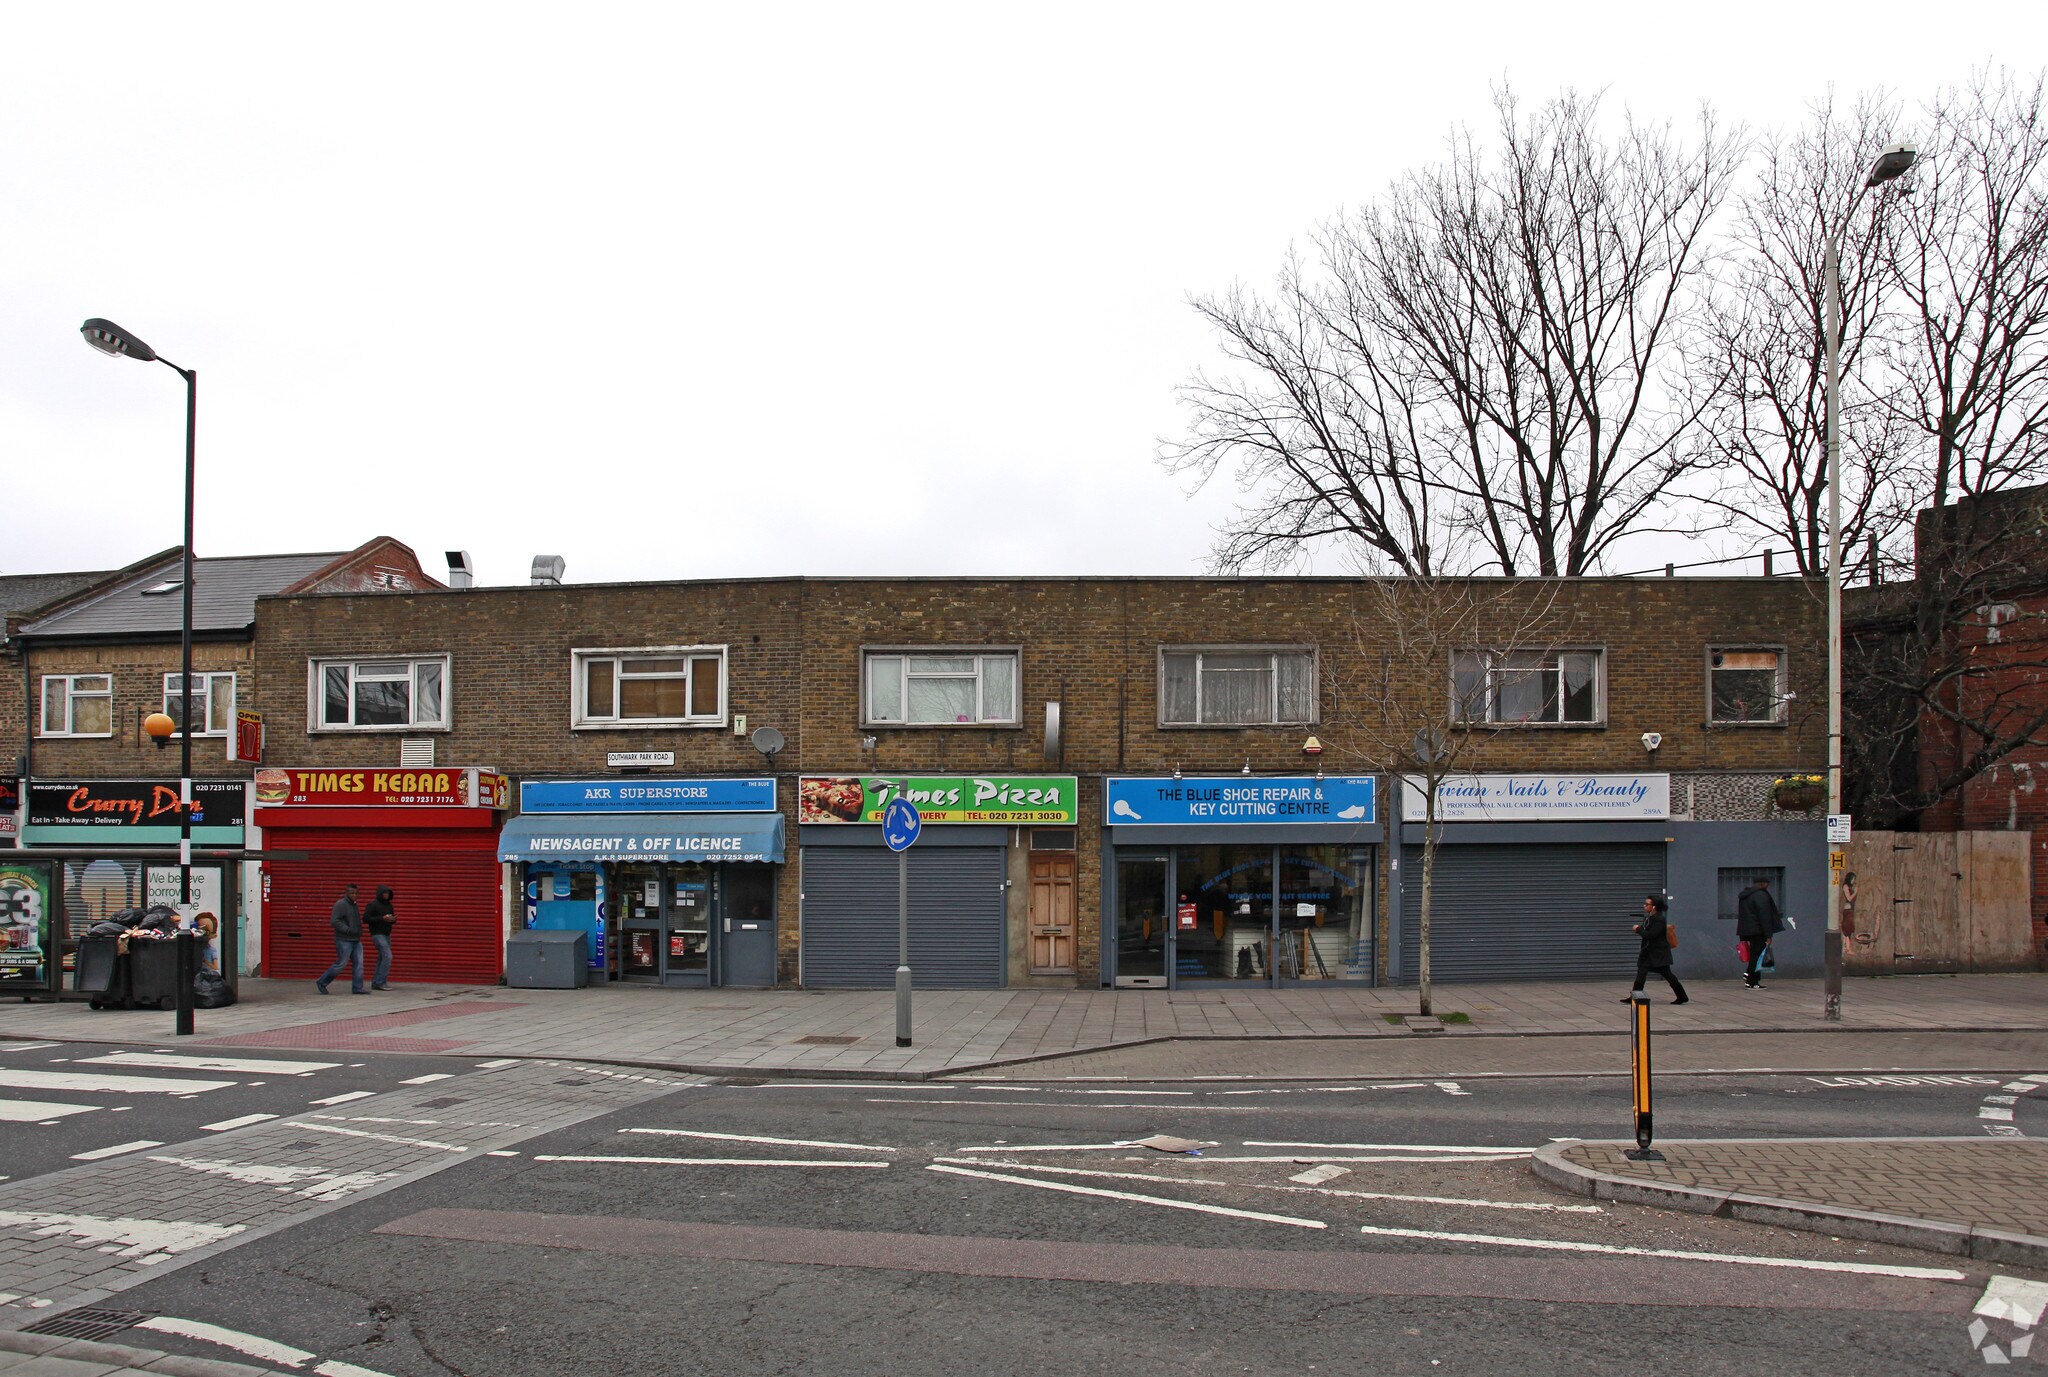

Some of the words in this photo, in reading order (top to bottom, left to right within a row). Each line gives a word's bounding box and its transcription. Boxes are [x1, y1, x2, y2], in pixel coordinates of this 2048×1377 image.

[238, 711, 260, 721] OPEN
[608, 753, 638, 761] SOUTHWARK
[639, 753, 653, 761] PARK
[297, 773, 365, 792] TIMES
[373, 773, 450, 793] KEBAB
[584, 788, 612, 799] AKR
[619, 787, 708, 799] SUPERSTORE
[877, 780, 960, 807] Tmes
[973, 779, 1061, 807] Pizza
[1157, 788, 1182, 801] THE
[1186, 788, 1220, 801] BLUE
[1223, 788, 1259, 801] SHOE
[1263, 787, 1311, 800] REPAIR
[1314, 787, 1323, 800] &
[1439, 782, 1491, 797] ivian
[1496, 778, 1552, 797] Nails
[1574, 778, 1651, 803] Beauty
[67, 786, 144, 825] Curry
[1189, 802, 1217, 816] KEY
[1219, 802, 1276, 816] CUTTING
[1278, 802, 1330, 815] CENTRE
[71, 816, 89, 825] Away
[94, 816, 123, 825] Delivery
[967, 812, 987, 820] TEL:
[989, 812, 1008, 820] 020
[1010, 812, 1034, 820] 7231
[1037, 812, 1062, 820] 3030
[529, 837, 622, 851] NEWSAGENT
[626, 838, 637, 851] &
[642, 837, 671, 851] OFF
[675, 837, 742, 851] LICENCE
[148, 872, 165, 884] We
[1805, 1075, 2000, 1087] LOADING
